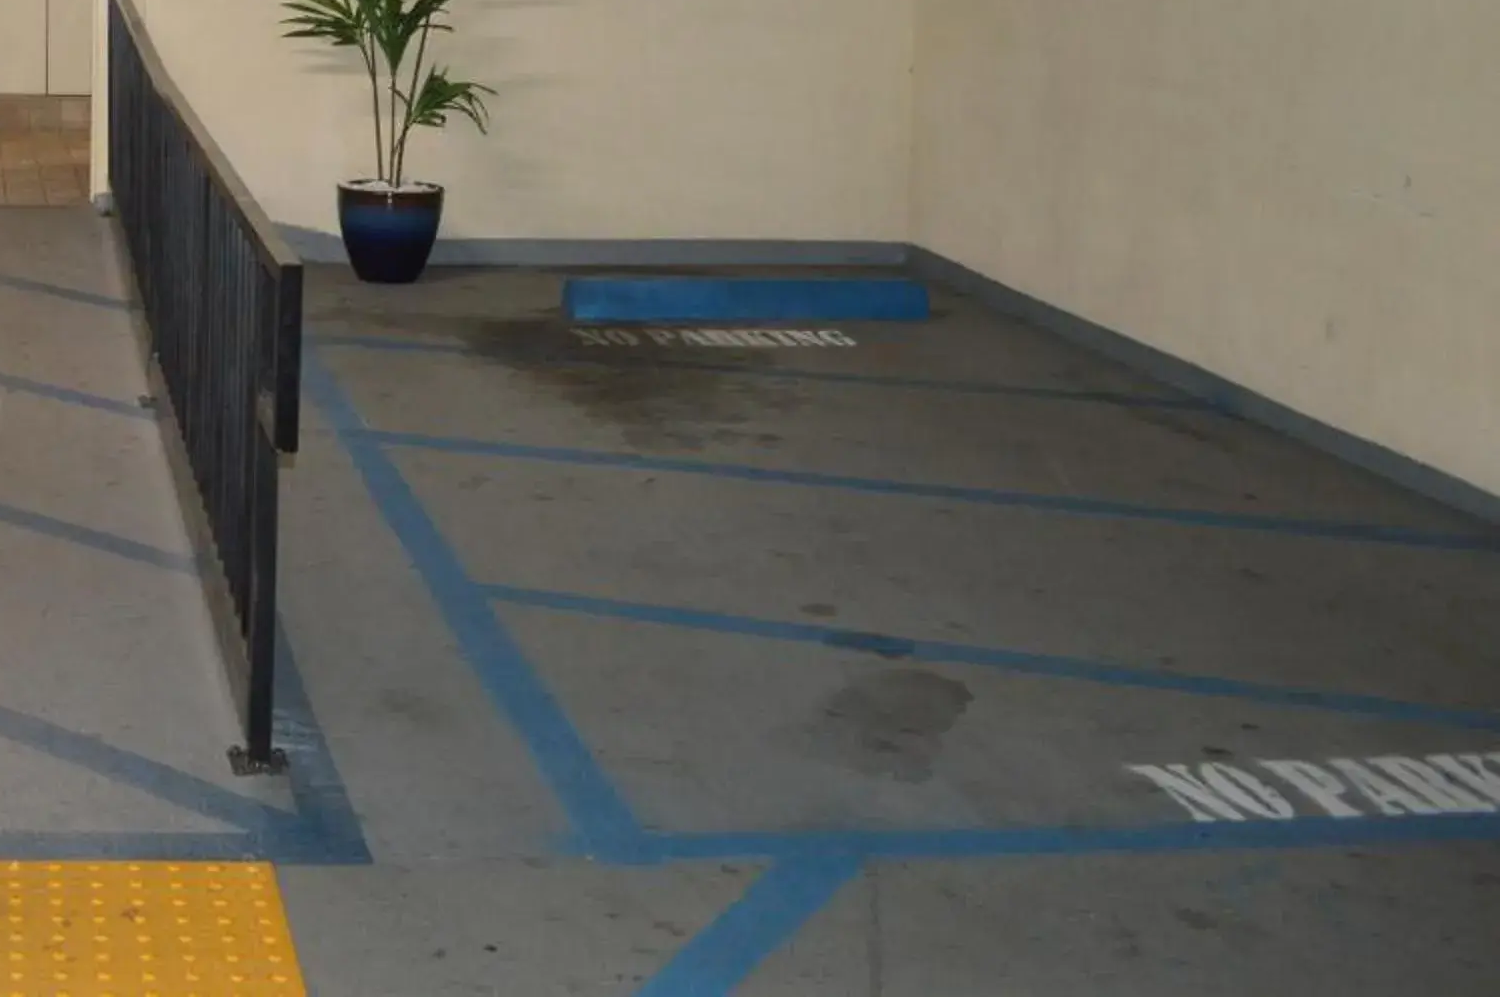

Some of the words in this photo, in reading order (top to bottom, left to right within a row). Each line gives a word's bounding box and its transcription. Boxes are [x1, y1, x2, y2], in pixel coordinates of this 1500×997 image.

[570, 328, 639, 347] NO
[650, 328, 857, 348] PARKING
[1124, 762, 1294, 822] NO
[1258, 753, 1500, 818] PARK
